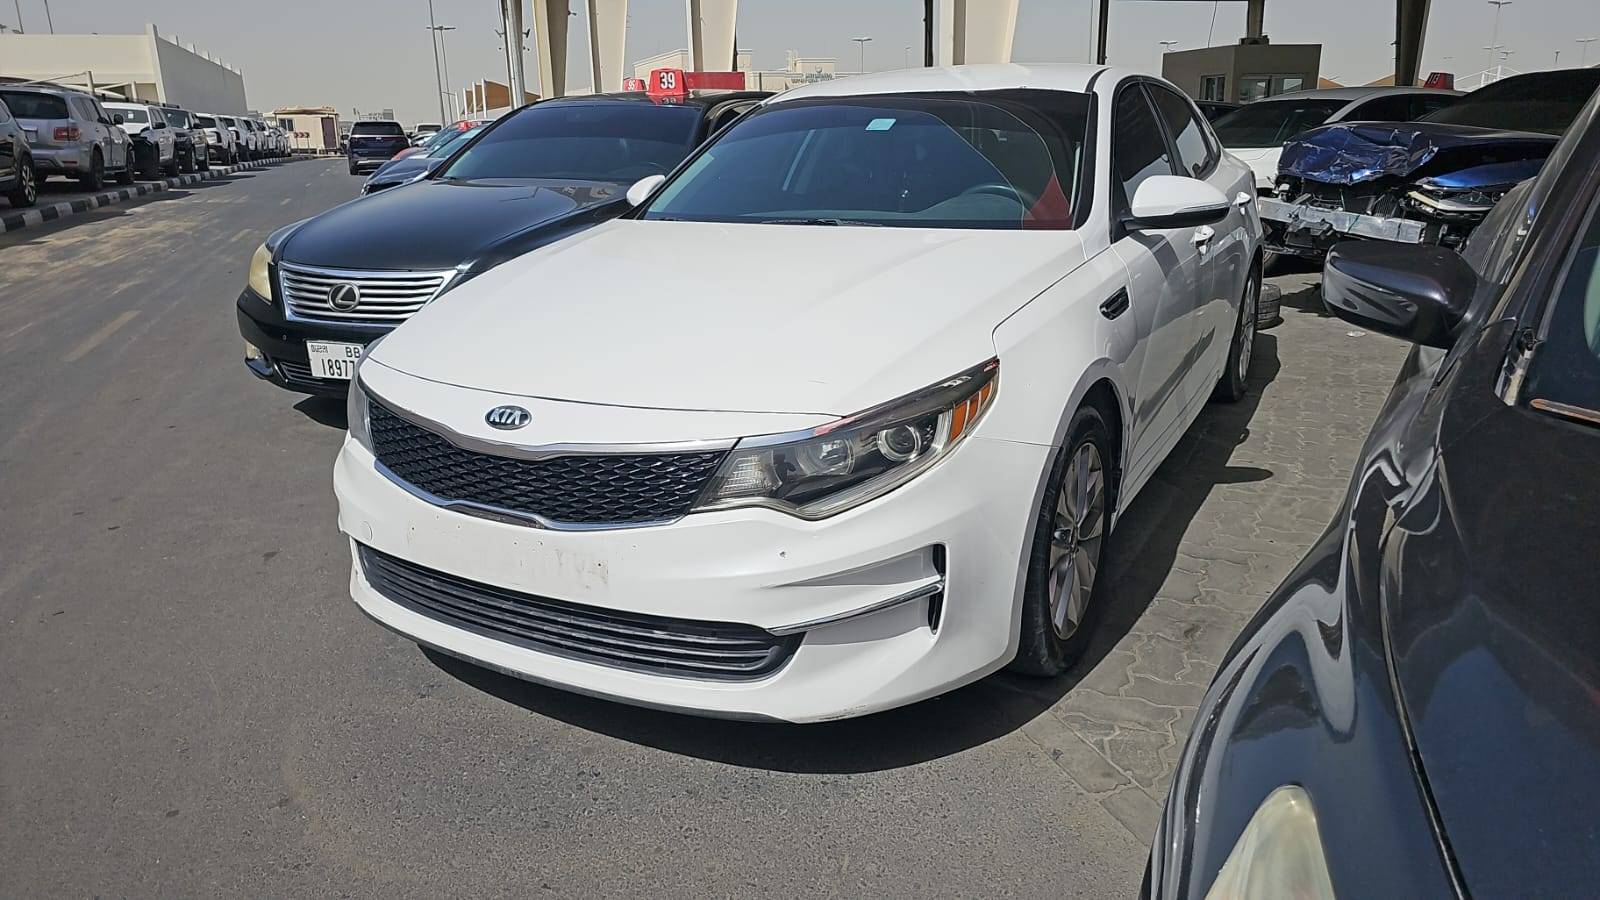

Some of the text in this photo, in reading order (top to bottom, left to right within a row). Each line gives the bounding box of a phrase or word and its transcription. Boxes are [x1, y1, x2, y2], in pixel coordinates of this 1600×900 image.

[660, 72, 676, 89] 39
[345, 346, 361, 358] BB
[321, 359, 355, 377] 18977
[489, 408, 522, 425] KIA
